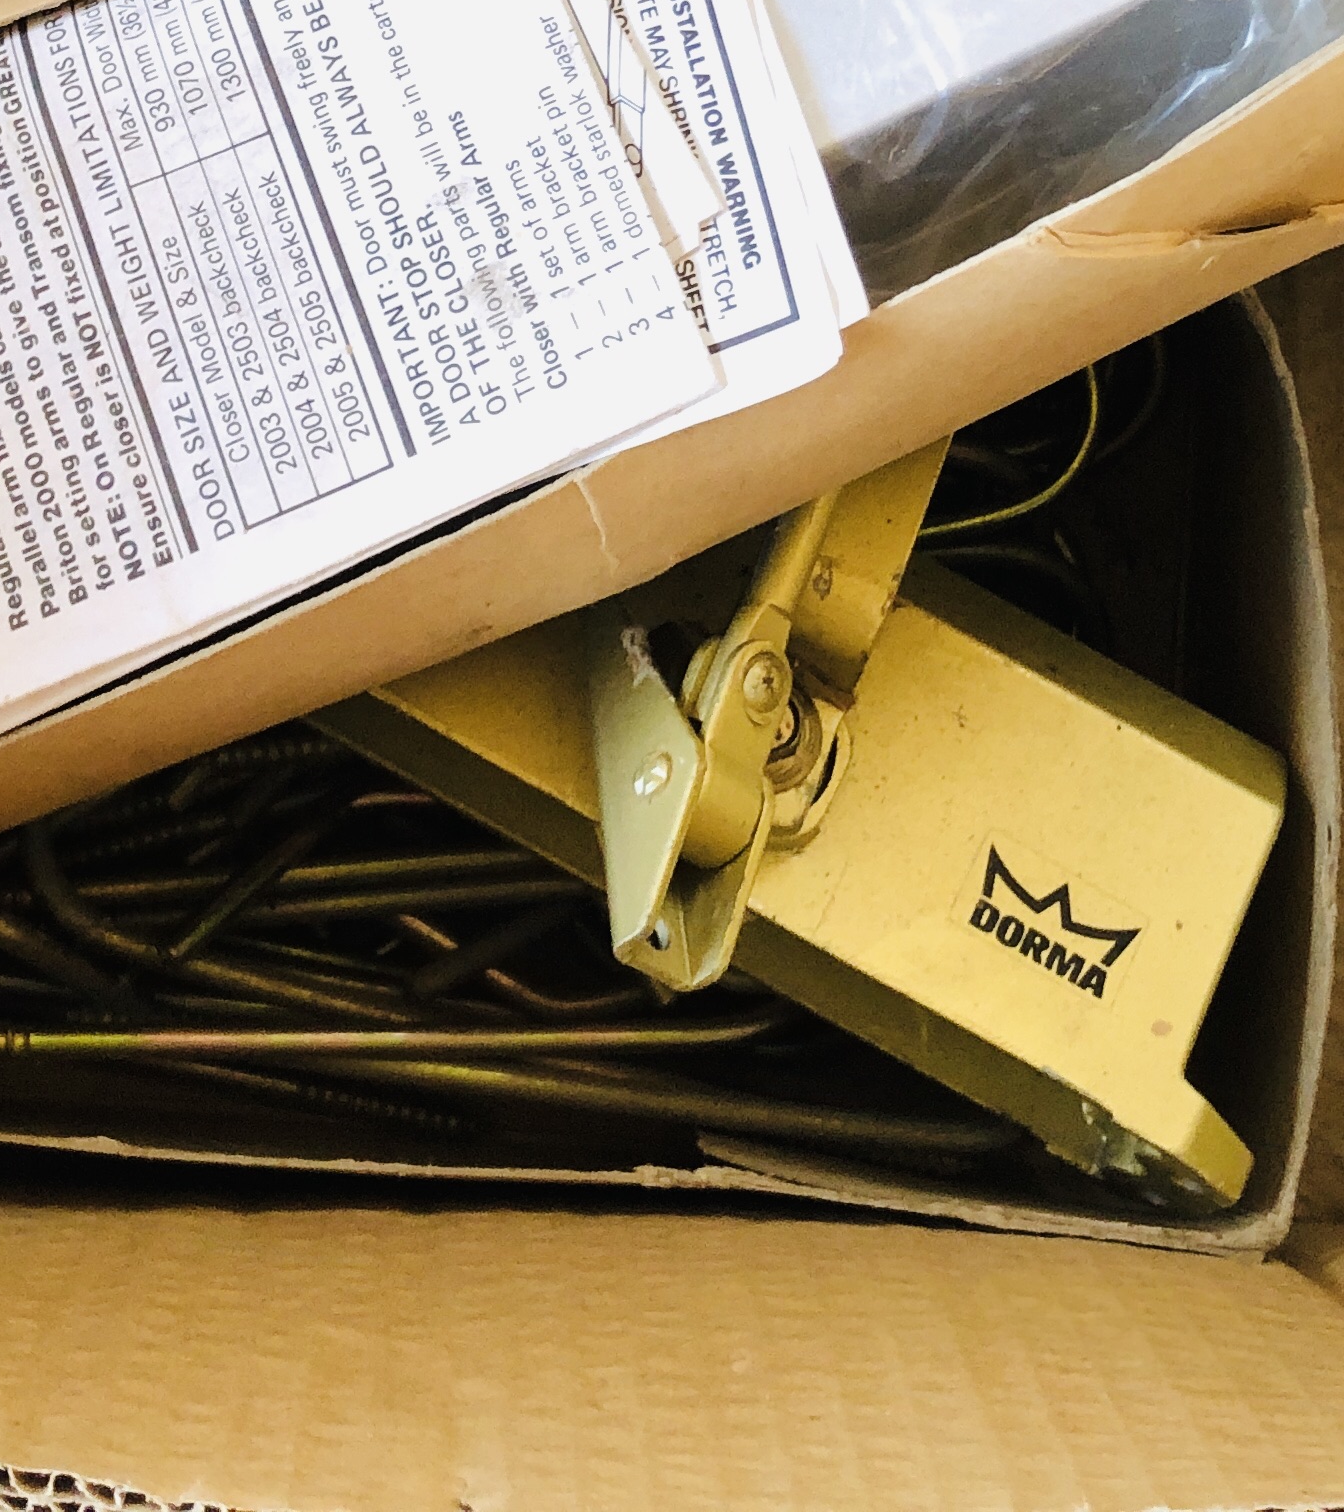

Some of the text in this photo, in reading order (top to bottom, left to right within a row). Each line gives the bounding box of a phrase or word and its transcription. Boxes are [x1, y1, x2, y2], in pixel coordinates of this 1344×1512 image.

[133, 43, 176, 132] 930 mm
[164, 18, 208, 115] 1070 mm
[201, 5, 246, 102] 1300 mm
[282, 29, 317, 90] freely
[316, 35, 372, 135] ALWAYS
[387, 44, 411, 80] the
[401, 83, 421, 107] in
[643, 24, 674, 70] MAY
[95, 44, 143, 152] Max. Door
[307, 91, 342, 153] swing
[412, 108, 433, 138] be
[538, 16, 643, 238] domed starlok washer
[12, 116, 60, 213] position
[330, 155, 365, 212] must
[358, 144, 413, 250] SHOULD
[419, 140, 451, 182] will
[525, 135, 590, 265] arm bracket
[537, 85, 617, 253] arm bracket pin
[6, 192, 50, 301] Transom
[41, 214, 64, 239] at
[353, 218, 388, 275] Door
[441, 184, 479, 241] parts
[447, 110, 567, 389] Closer with Regular Arms
[504, 159, 563, 278] set of arms
[716, 152, 762, 271] WARNING
[37, 12, 235, 541] DOOR SIZE AND WEIGHT LIMITATIONS FOR
[49, 242, 86, 304] fixed
[257, 170, 370, 442] 2005 2505 backcheck
[399, 256, 440, 320] STOP
[415, 202, 507, 415] OF THE CLOSER.
[465, 243, 516, 350] following
[674, 257, 711, 333] SHEET
[699, 216, 739, 321] TRETCH,
[36, 300, 67, 345] and
[71, 310, 105, 361] NOT
[161, 235, 250, 463] Closer Model Size
[186, 199, 298, 474] 2003 2503 backcheck
[221, 186, 333, 460] 2004 2504 backcheck
[376, 279, 451, 446] IMPORTANT:
[427, 323, 471, 404] DOOR
[56, 351, 102, 452] Regular
[94, 362, 113, 387] is
[509, 354, 535, 403] The
[93, 451, 115, 491] On
[103, 390, 141, 468] closer
[0, 465, 29, 518] arm
[105, 492, 146, 582] NOTE:
[131, 473, 174, 568] Ensure
[13, 519, 61, 619] Parallel
[968, 899, 1109, 999] DORMA
